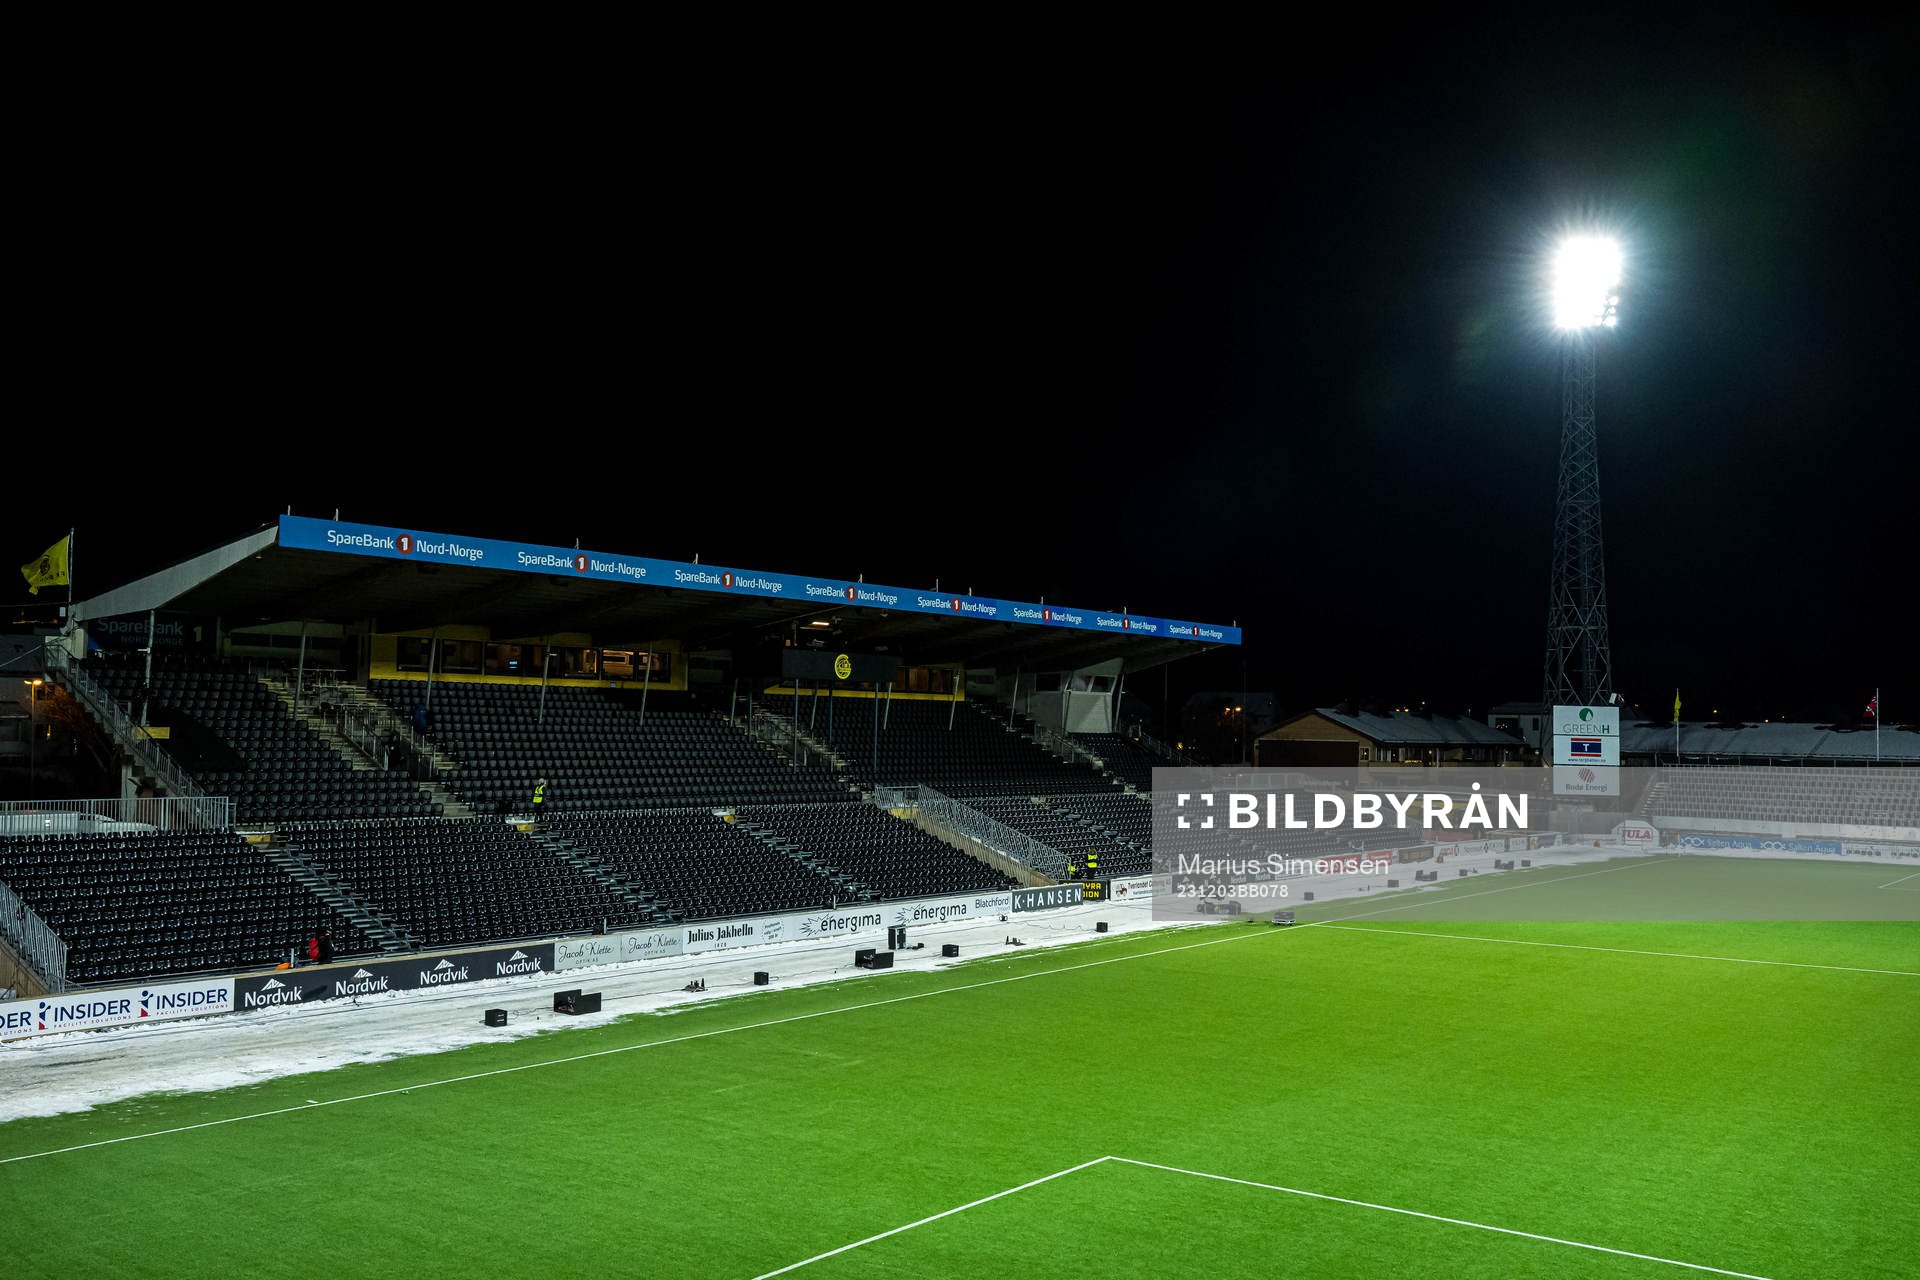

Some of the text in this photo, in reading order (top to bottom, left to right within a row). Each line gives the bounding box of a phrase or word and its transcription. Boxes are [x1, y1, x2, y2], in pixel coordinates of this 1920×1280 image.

[327, 530, 394, 549] SpareBank
[416, 540, 483, 561] Nord-Norge
[518, 551, 573, 569] SpareBank
[591, 559, 647, 578] Nord-Norge
[674, 569, 720, 585] SpareBank
[735, 576, 782, 592] Nord-Norge
[806, 584, 845, 599] SpareBank
[857, 590, 898, 604] Nord-Norge
[917, 597, 952, 610] SpareBank
[961, 601, 997, 615] Nord-Norge
[1013, 607, 1043, 619] SpareBank
[1051, 611, 1082, 624] Nord-Norge
[1096, 617, 1122, 628] SpareBank
[1563, 723, 1610, 734] GREENH
[1582, 743, 1590, 752] T
[1586, 784, 1607, 792] Energi
[913, 903, 967, 921] energima
[975, 897, 1009, 909] Blatchford
[820, 912, 881, 933] energima
[687, 926, 714, 944] Julius
[716, 923, 753, 942] Jakhelln
[558, 944, 584, 963] Jacob
[628, 936, 652, 954] Jacob
[420, 966, 468, 985] Nordvik
[496, 957, 541, 975] Nordvik
[335, 976, 388, 996] Nordvik
[156, 988, 228, 1010] INSIDER
[244, 986, 302, 1008] Nordvik
[54, 999, 131, 1022] INSIDER
